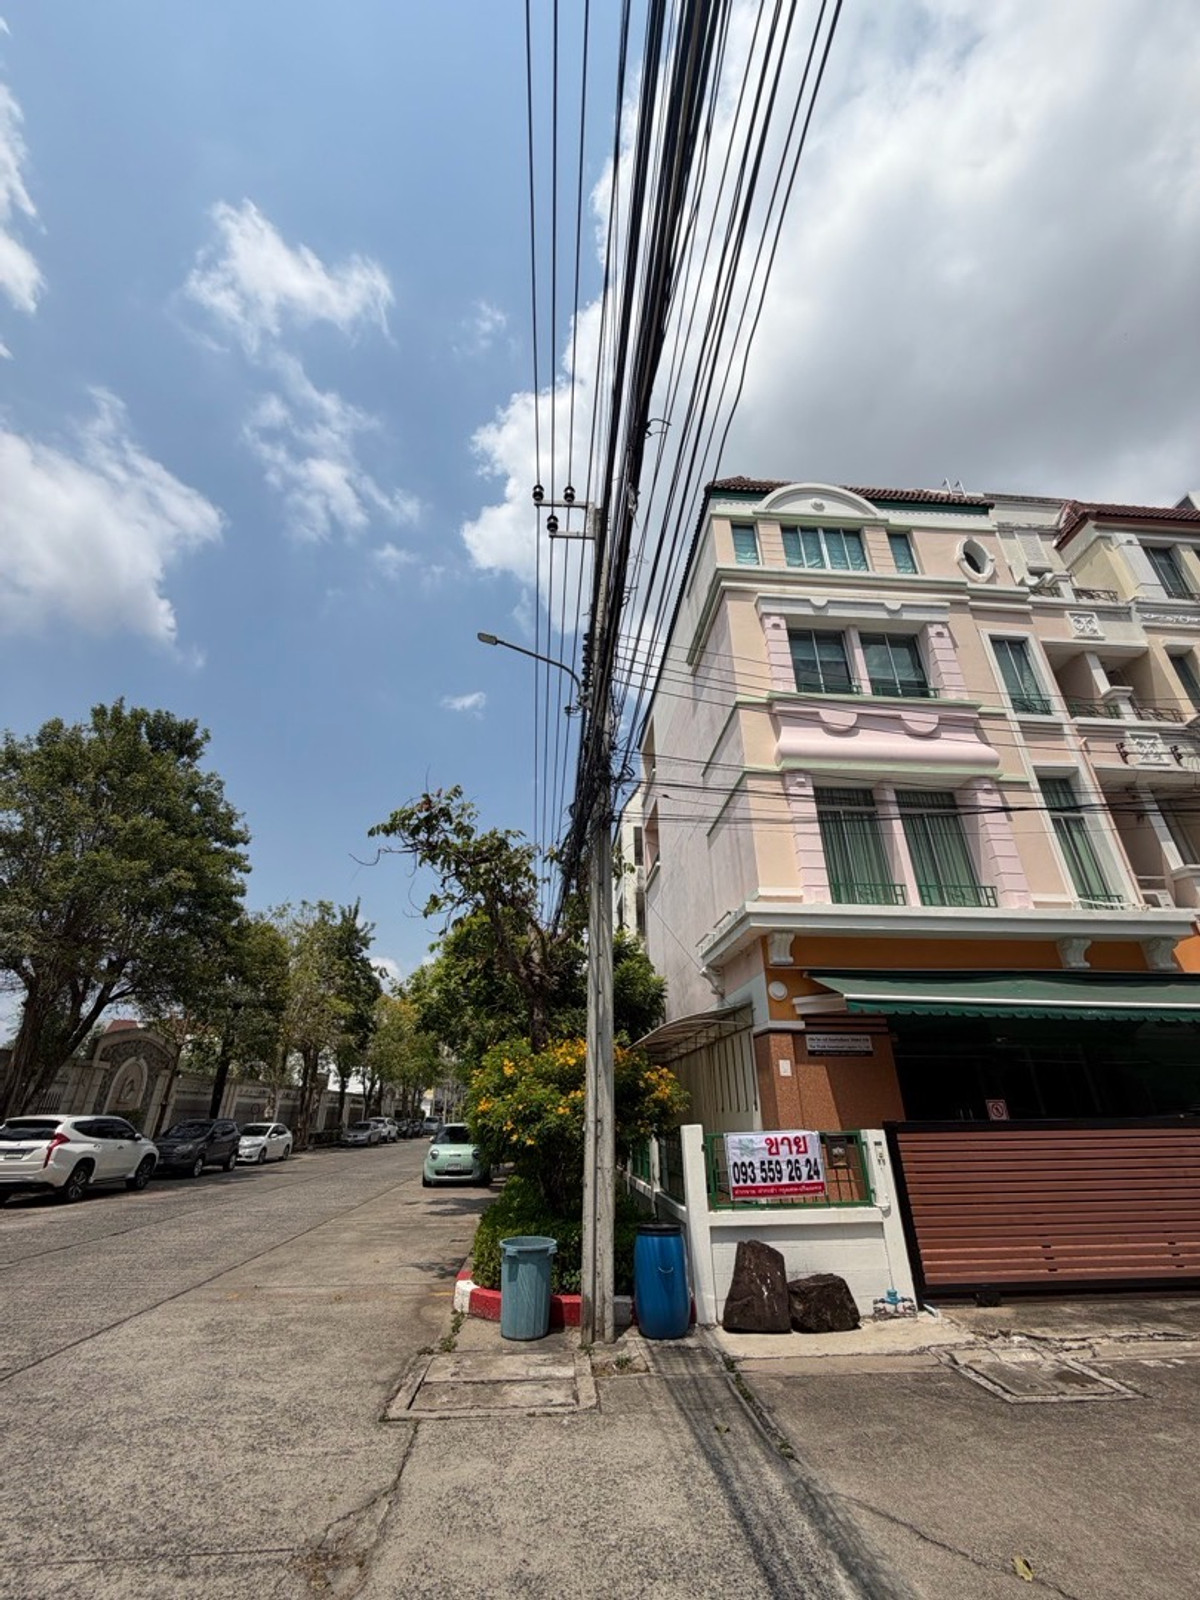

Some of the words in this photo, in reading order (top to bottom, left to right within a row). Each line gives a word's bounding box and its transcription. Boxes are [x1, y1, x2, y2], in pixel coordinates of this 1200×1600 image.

[765, 1136, 808, 1156] ขาย
[733, 1161, 756, 1184] 093
[760, 1159, 783, 1183] 559
[786, 1158, 802, 1181] 26
[805, 1158, 820, 1180] 24
